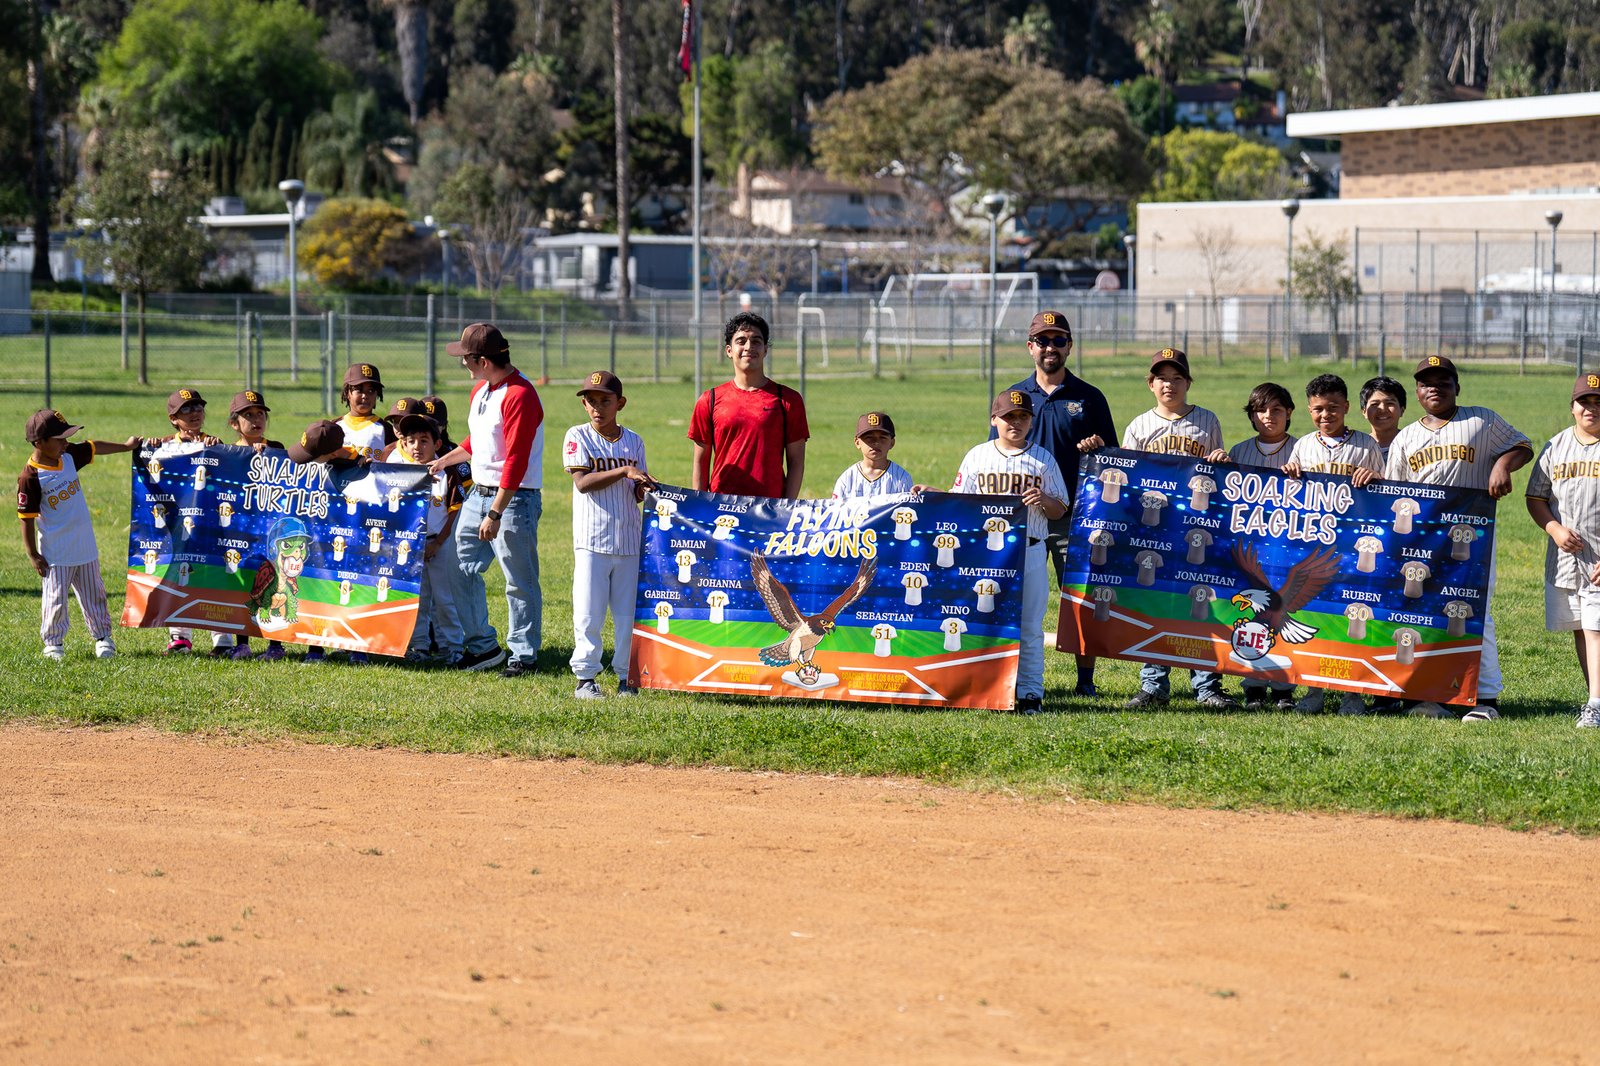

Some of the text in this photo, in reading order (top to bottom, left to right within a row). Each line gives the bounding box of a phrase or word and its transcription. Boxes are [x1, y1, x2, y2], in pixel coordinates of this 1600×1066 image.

[1428, 356, 1440, 366] SD
[191, 458, 219, 466] MOISES
[1094, 455, 1137, 468] YOUSEF
[247, 455, 333, 490] SNAPPY
[1195, 463, 1214, 474] GIL
[1140, 478, 1177, 490] MILAN
[217, 493, 237, 502] JUAN
[1222, 471, 1354, 514] SOARING
[1366, 483, 1446, 499] CHRISTOPHER
[145, 494, 176, 502] KAMILA
[242, 483, 329, 519] TURTLES
[717, 504, 748, 514] ELIAS
[981, 505, 1014, 515] NOAH
[1399, 502, 1411, 516] 2
[786, 503, 870, 531] FLYING
[895, 512, 913, 525] 53
[1183, 515, 1221, 529] LOGAN
[1440, 513, 1489, 526] MATTEO
[936, 522, 958, 531] LEO
[987, 520, 1006, 533] 20
[1080, 518, 1127, 531] ALBERTO
[1230, 503, 1337, 545] EAGLES
[1360, 524, 1382, 535] LEO
[140, 541, 162, 549] DAISY
[217, 538, 249, 549] MATEO
[670, 540, 706, 549] DAMIAN
[764, 529, 877, 559] FALCONS
[937, 536, 955, 549] 99
[1129, 537, 1172, 551] MATIAS
[1401, 547, 1432, 559] LIAM
[900, 562, 931, 572] EDEN
[1141, 556, 1153, 569] 4
[958, 567, 1017, 578] MATTHEW
[1090, 573, 1122, 585] DAVID
[1174, 570, 1235, 587] JONATHAN
[697, 579, 742, 589] JOHANNA
[905, 576, 923, 589] 10
[644, 590, 681, 600] GABRIEL
[977, 583, 995, 596] 14
[1094, 587, 1112, 602] 10
[1341, 589, 1382, 602] RUBEN
[1440, 586, 1480, 599] ANGEL
[855, 611, 914, 622] SEBASTIAN
[941, 605, 970, 615] NINO
[1347, 606, 1369, 621] 30
[1388, 612, 1433, 626] JOSEPH
[875, 628, 891, 641] 51
[949, 622, 958, 635] 3
[1236, 630, 1267, 650] EJE
[1400, 632, 1412, 647] 8
[1175, 647, 1201, 658] KAREN
[1319, 667, 1351, 679] ERIKA
